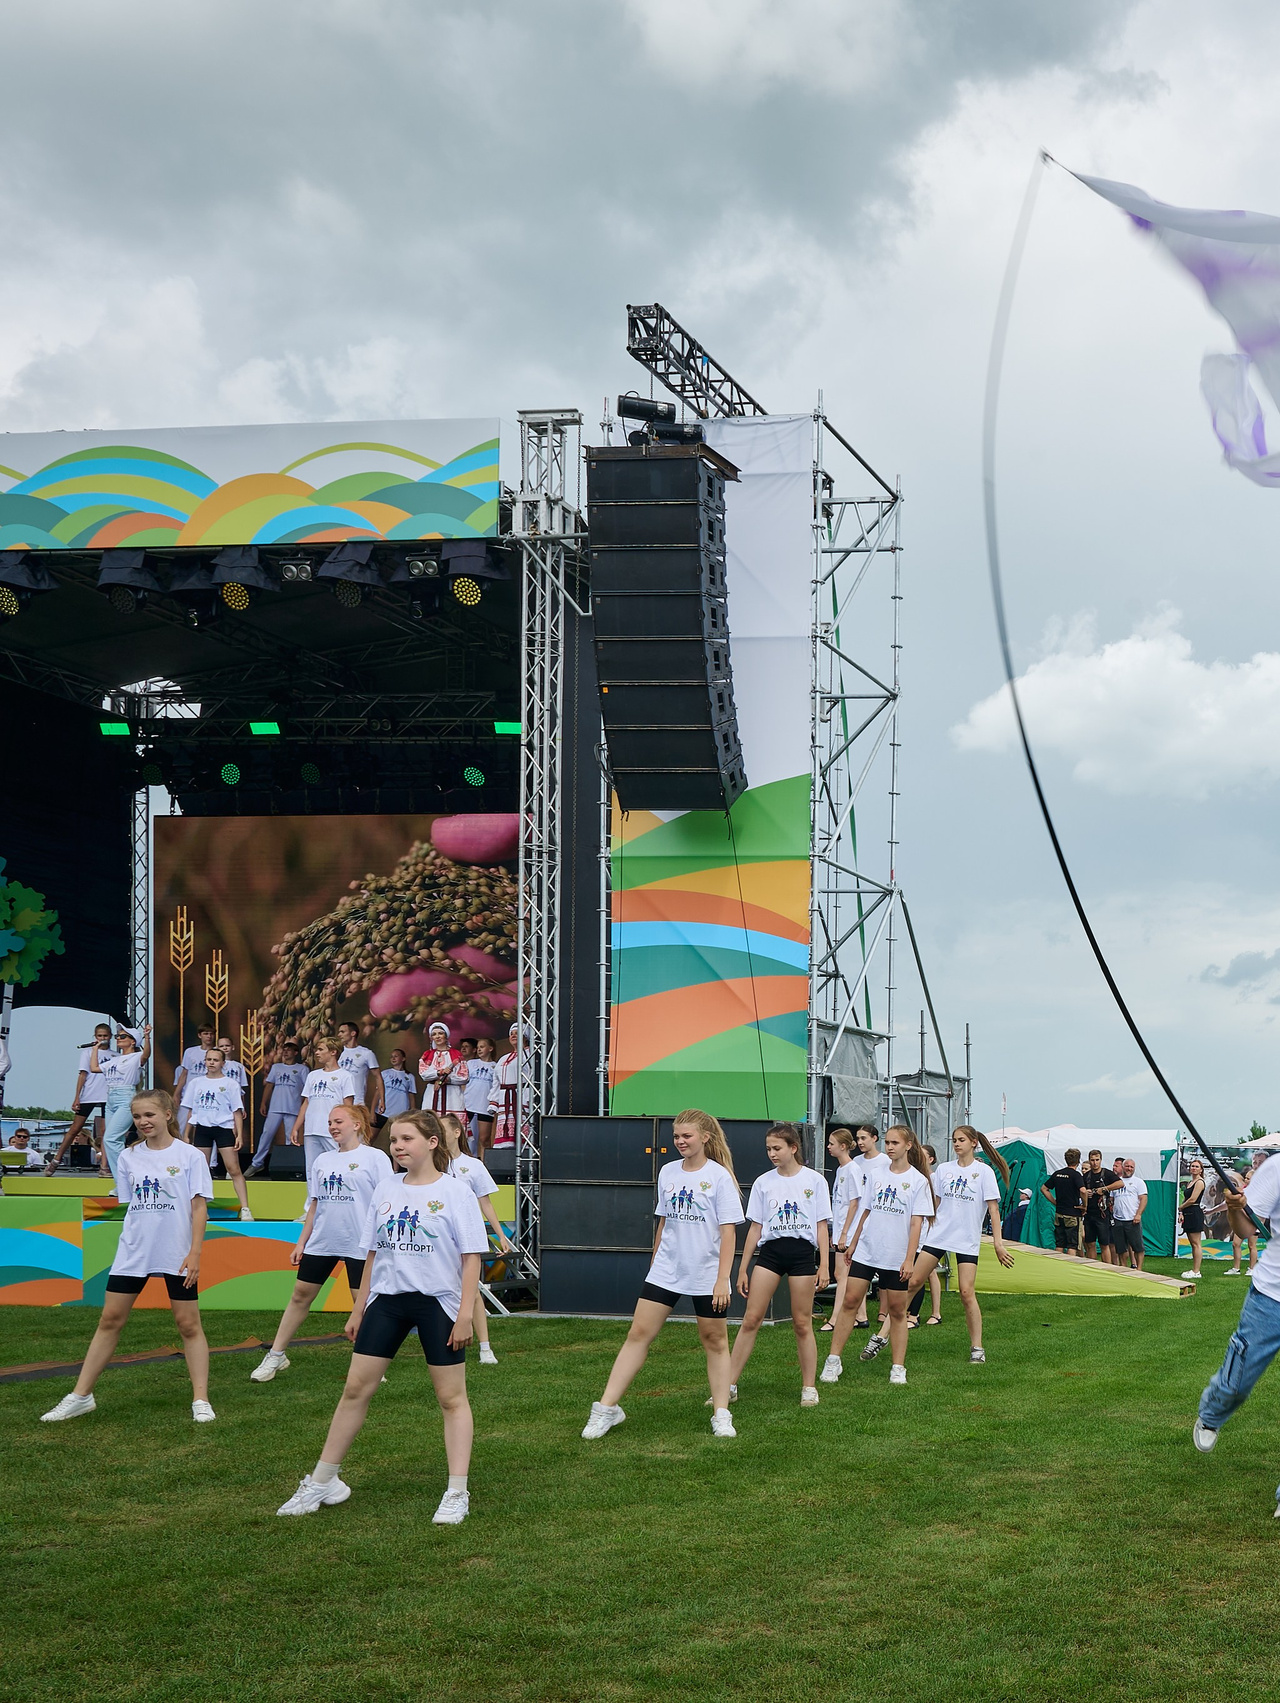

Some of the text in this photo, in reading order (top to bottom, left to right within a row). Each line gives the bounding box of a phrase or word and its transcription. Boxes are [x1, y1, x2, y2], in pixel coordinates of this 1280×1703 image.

[955, 1194, 975, 1202] СПОРТА
[146, 1203, 175, 1211] СПОРТА
[883, 1206, 904, 1215] СПОРТА
[679, 1214, 706, 1222] СПОРТА
[399, 1243, 435, 1253] СПОРТА
